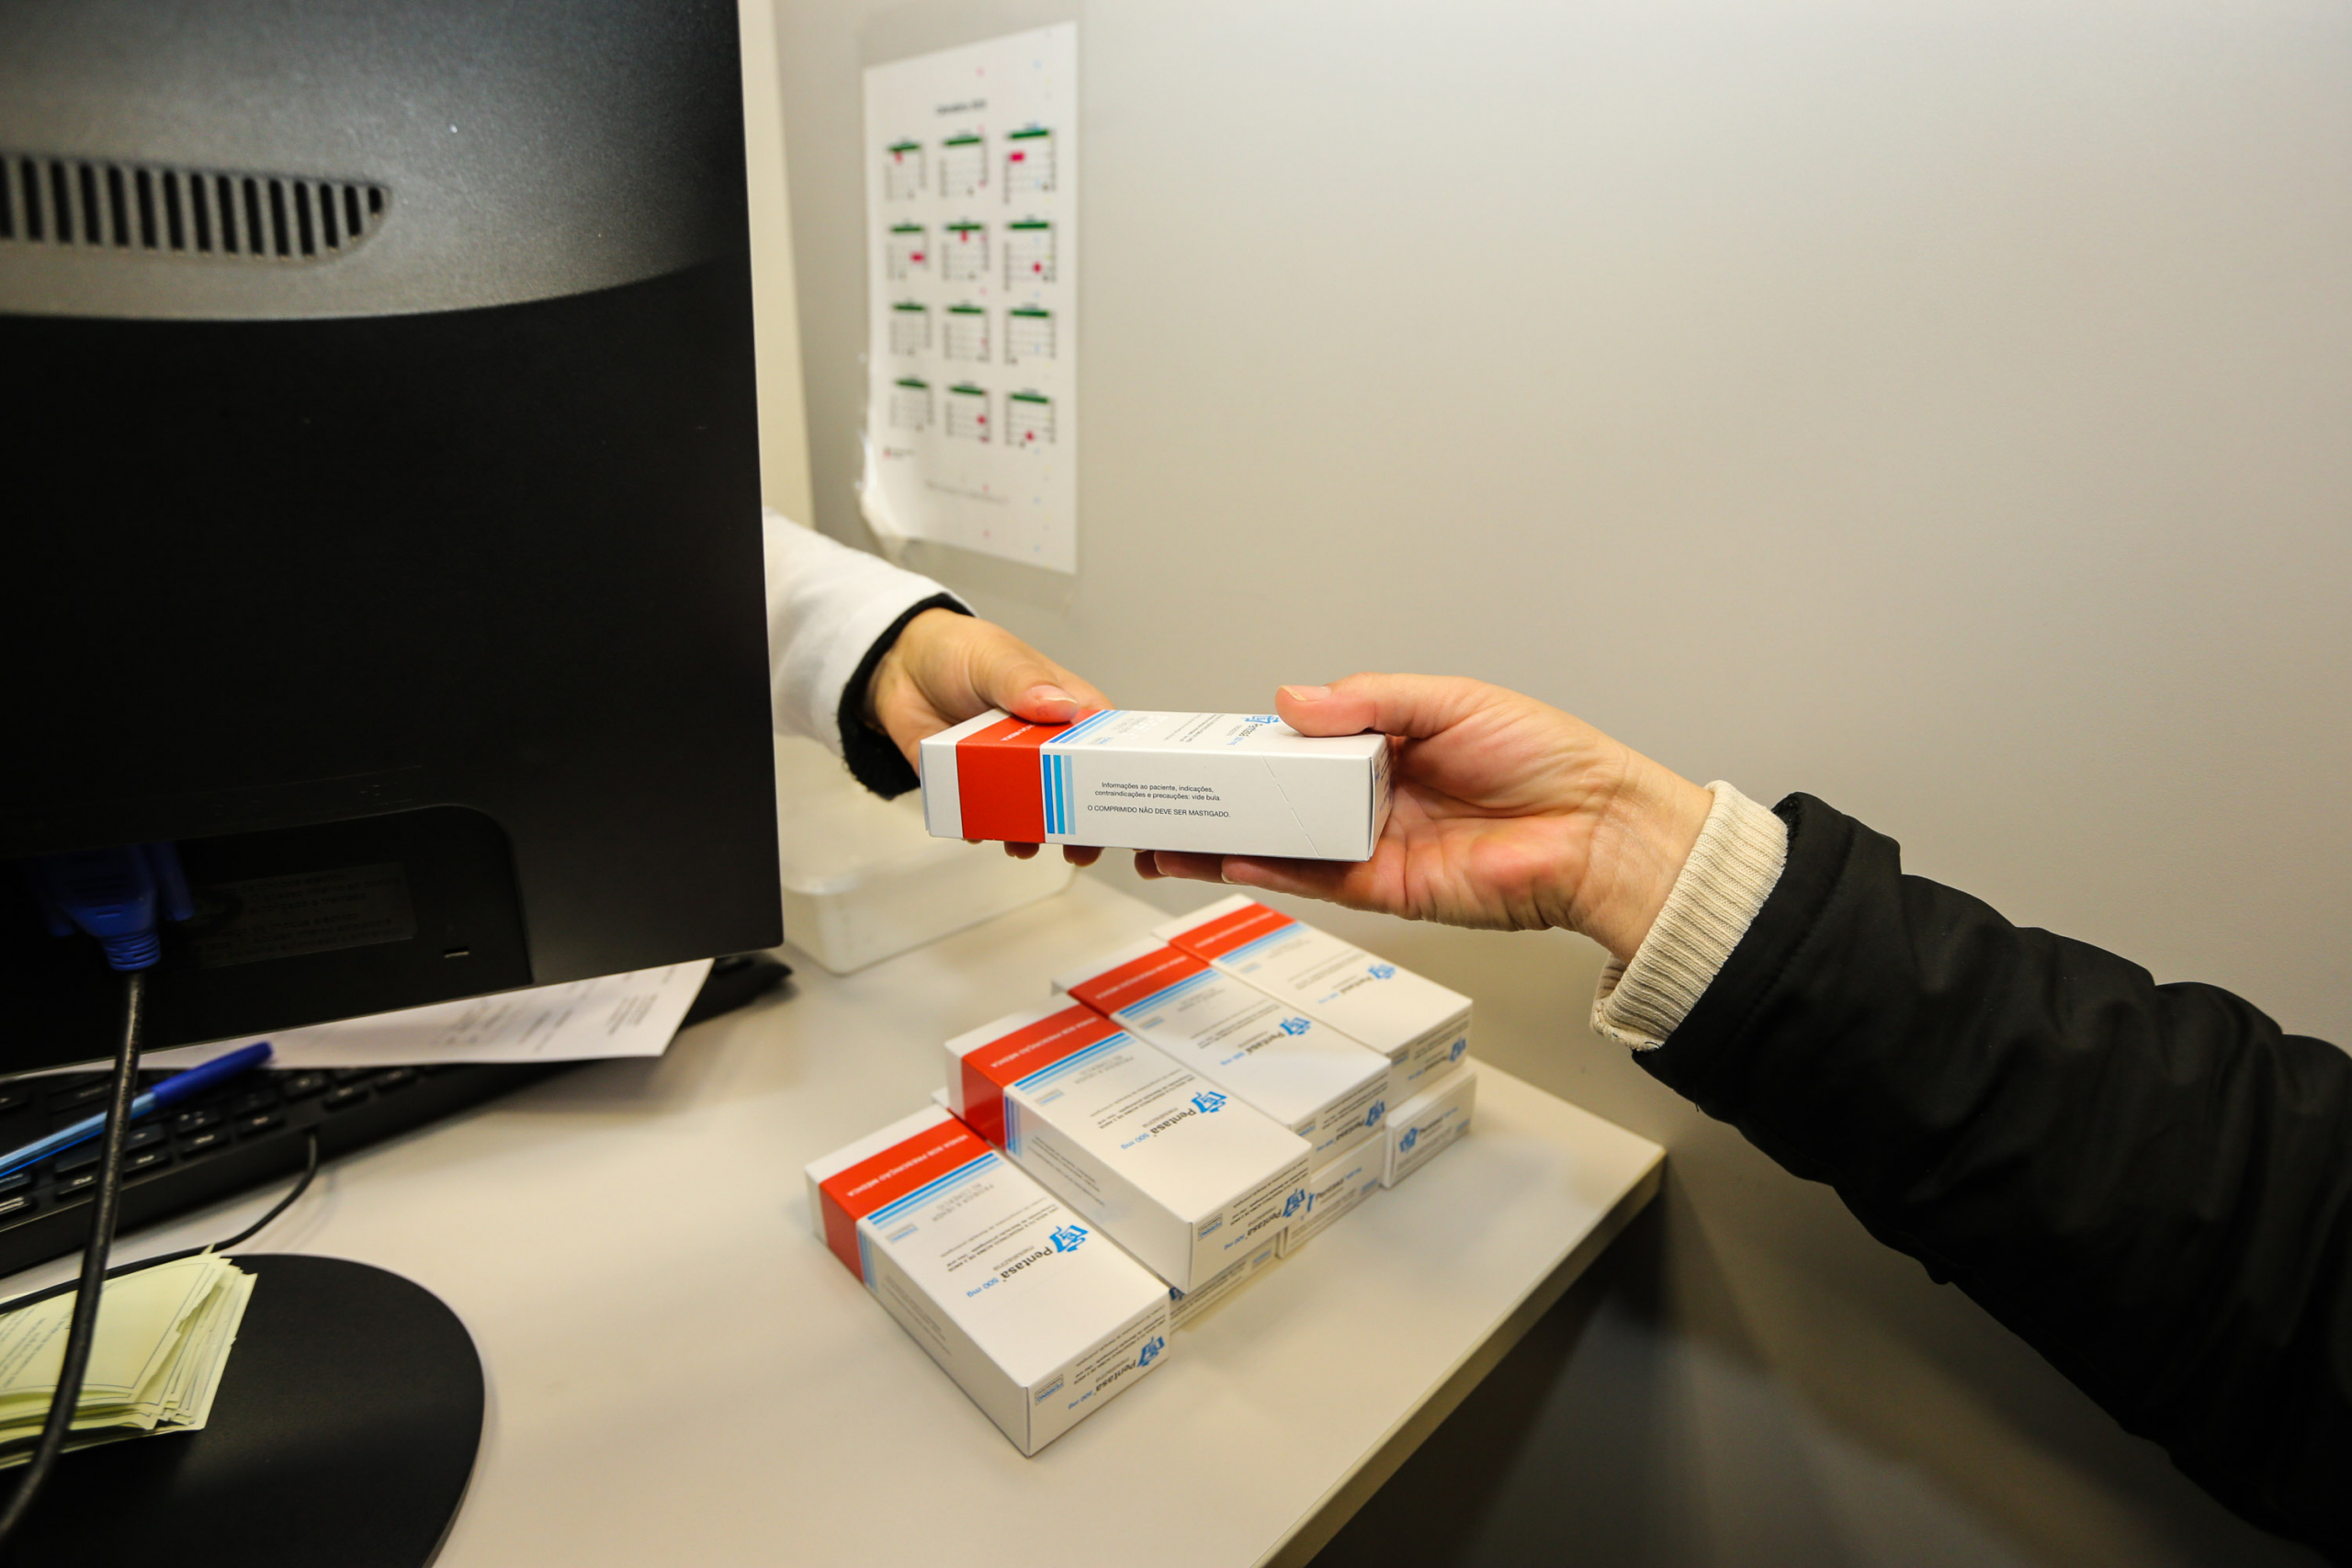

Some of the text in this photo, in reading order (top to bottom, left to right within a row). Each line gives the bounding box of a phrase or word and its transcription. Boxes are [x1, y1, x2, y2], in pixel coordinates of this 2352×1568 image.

[1094, 790, 1146, 798] contraindicações
[1102, 782, 1138, 790] Informações
[1093, 805, 1137, 813] COMPRIMIDO
[1188, 809, 1230, 818] MASTIGADO.
[1120, 1108, 1196, 1150] Pentasa 500 mg
[847, 1179, 879, 1197] MÉDICA
[992, 1247, 1034, 1271] mesalazina
[966, 1247, 1053, 1298] Pentasa 500 mg
[1095, 1359, 1136, 1392] Pentasa
